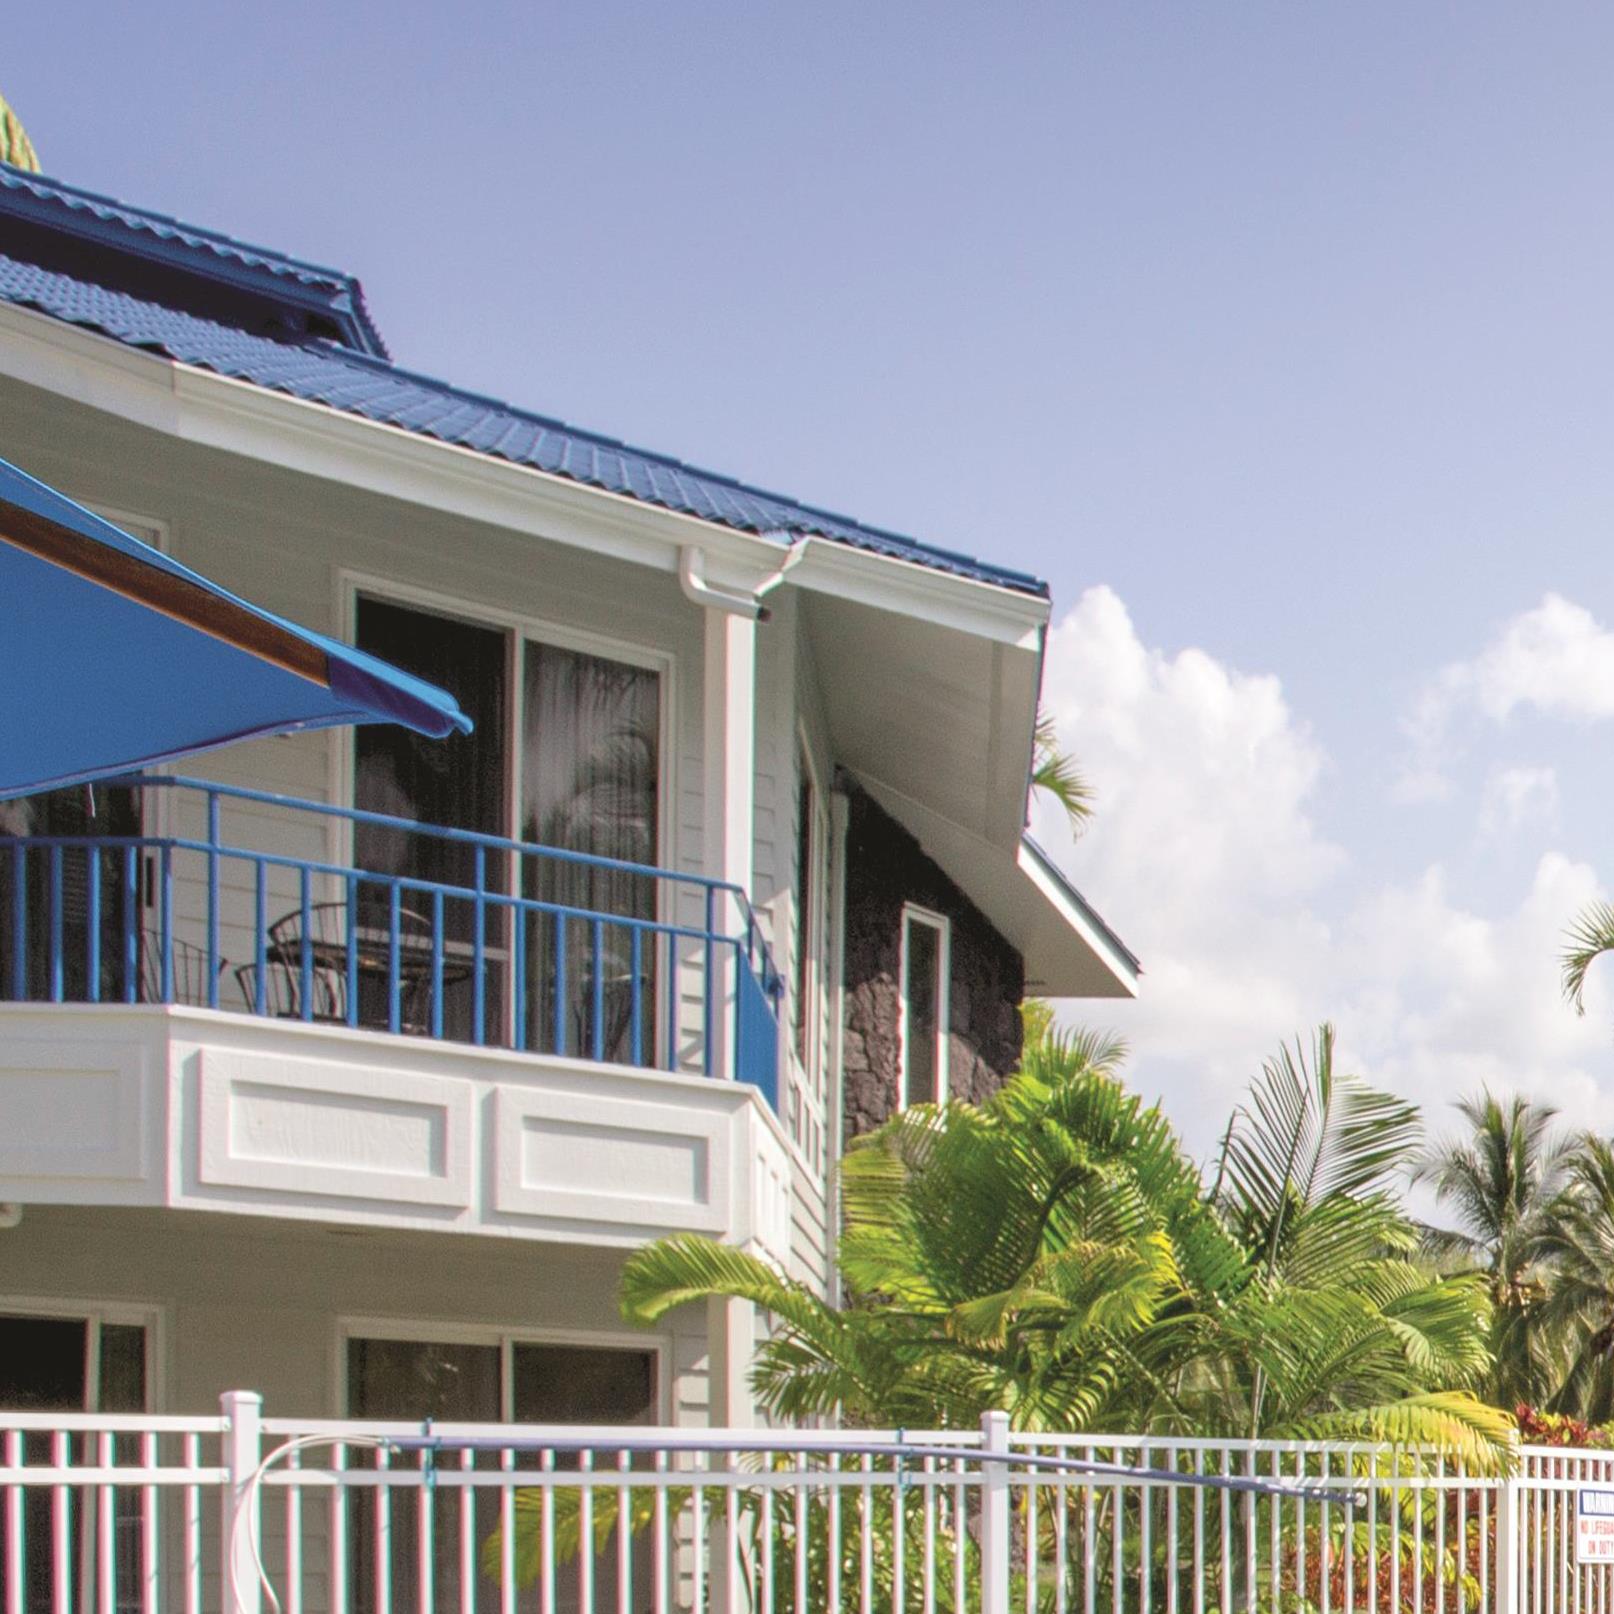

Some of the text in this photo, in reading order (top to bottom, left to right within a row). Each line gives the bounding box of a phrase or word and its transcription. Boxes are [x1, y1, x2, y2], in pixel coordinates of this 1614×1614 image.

[1581, 1520, 1589, 1534] NO
[1588, 1540, 1614, 1555] ON DUTY
